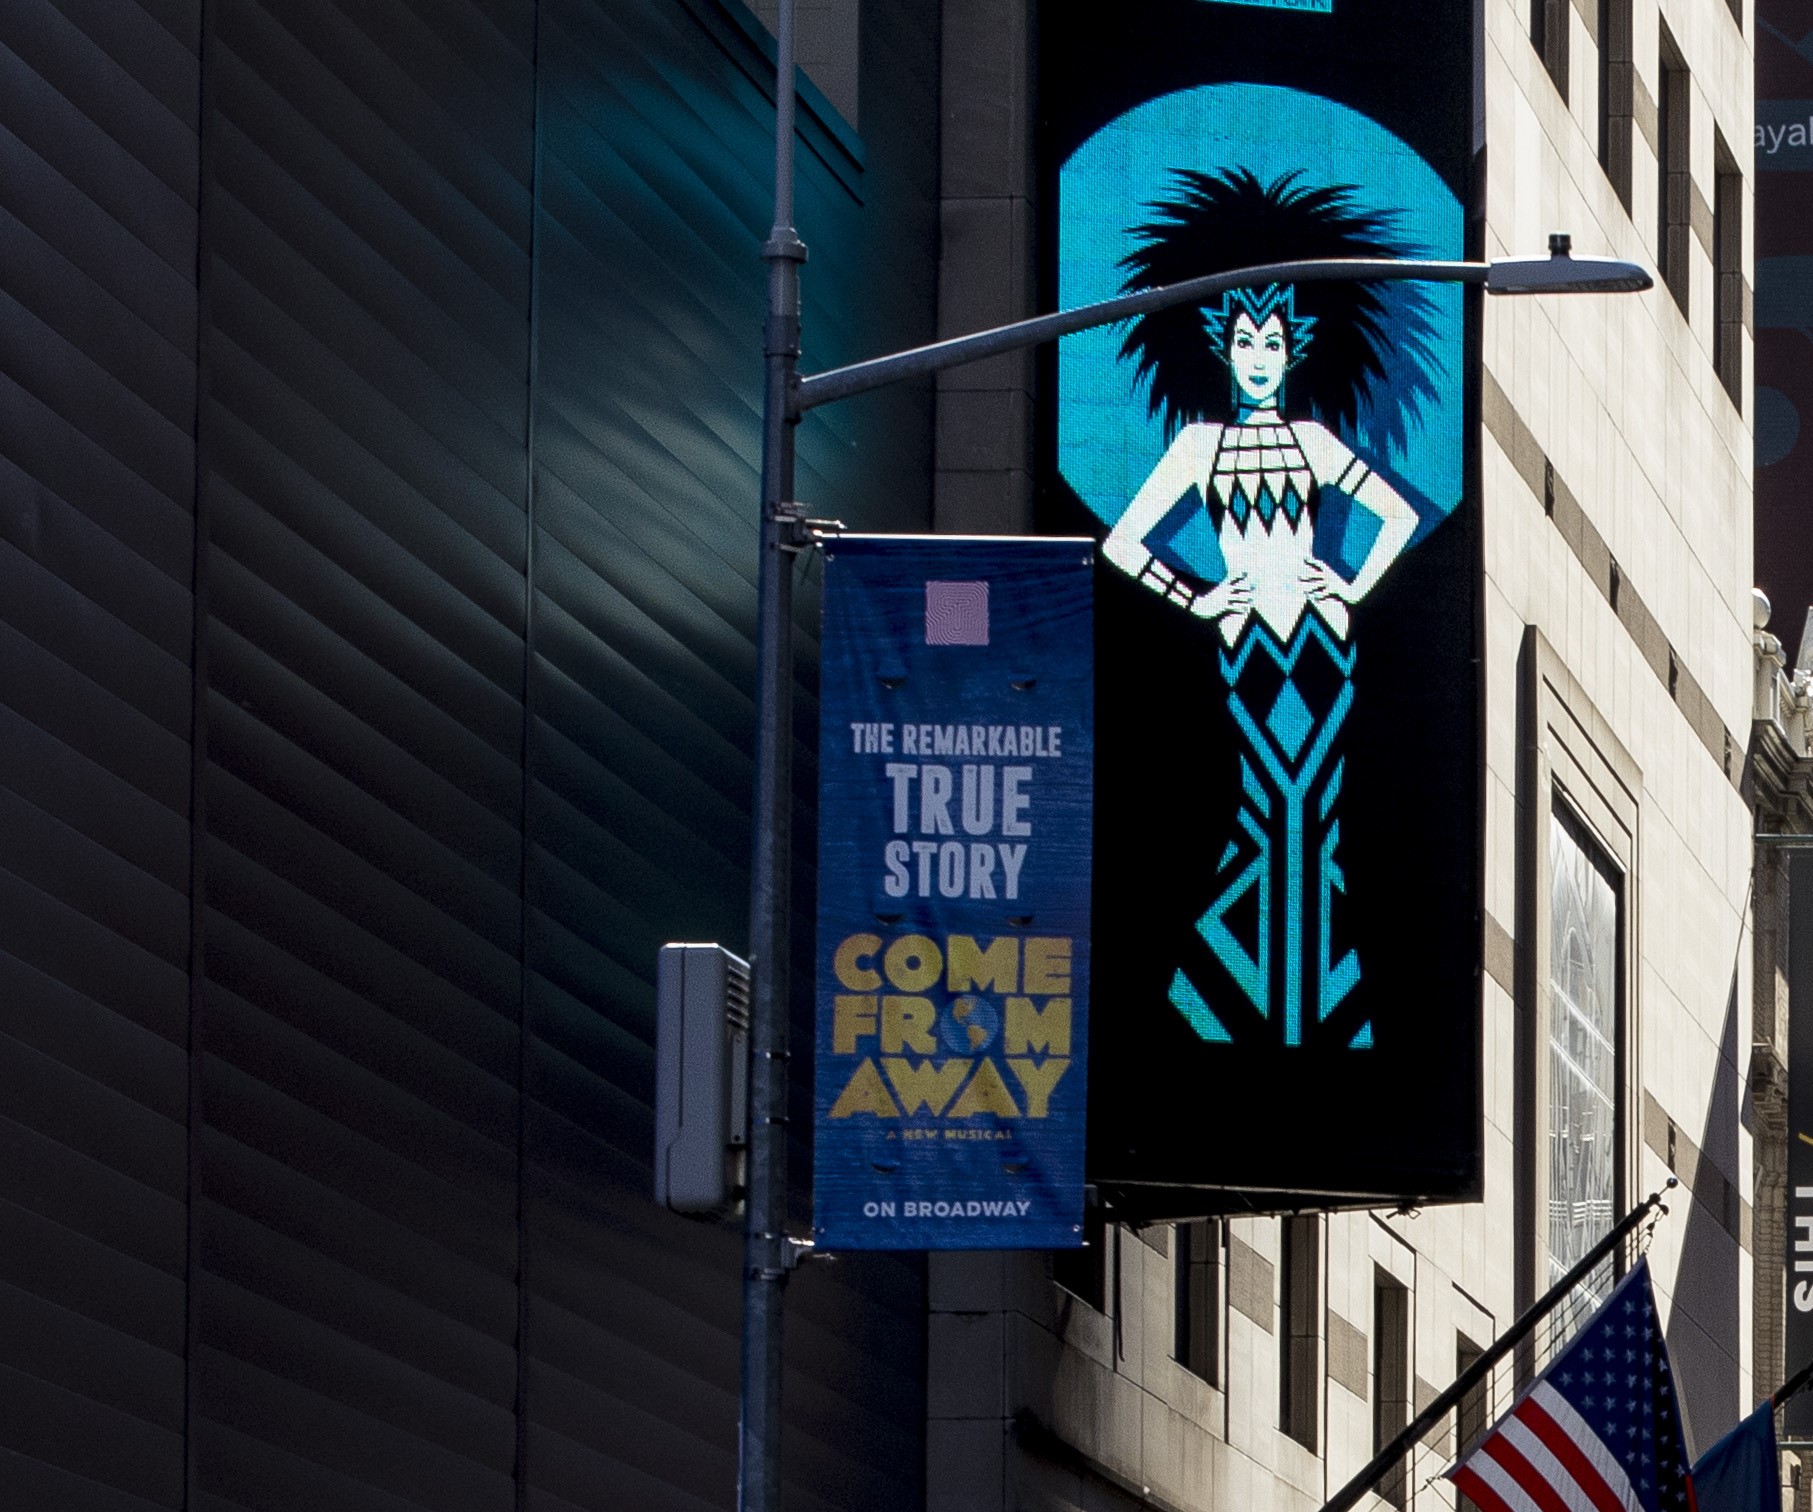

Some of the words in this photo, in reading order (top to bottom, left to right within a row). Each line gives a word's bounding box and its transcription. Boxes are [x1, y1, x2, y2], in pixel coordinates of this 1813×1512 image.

[851, 723, 896, 754] THE
[902, 723, 1062, 757] REMARKABLE
[886, 763, 1032, 837] TRUE
[884, 840, 1028, 900] STORY
[833, 934, 1071, 995] COME
[828, 1057, 1070, 1120] AWAY
[902, 1129, 938, 1142] NEW
[942, 1129, 1013, 1142] MUSICAL
[863, 1202, 898, 1218] ON
[903, 1201, 1031, 1218] BROADWAY
